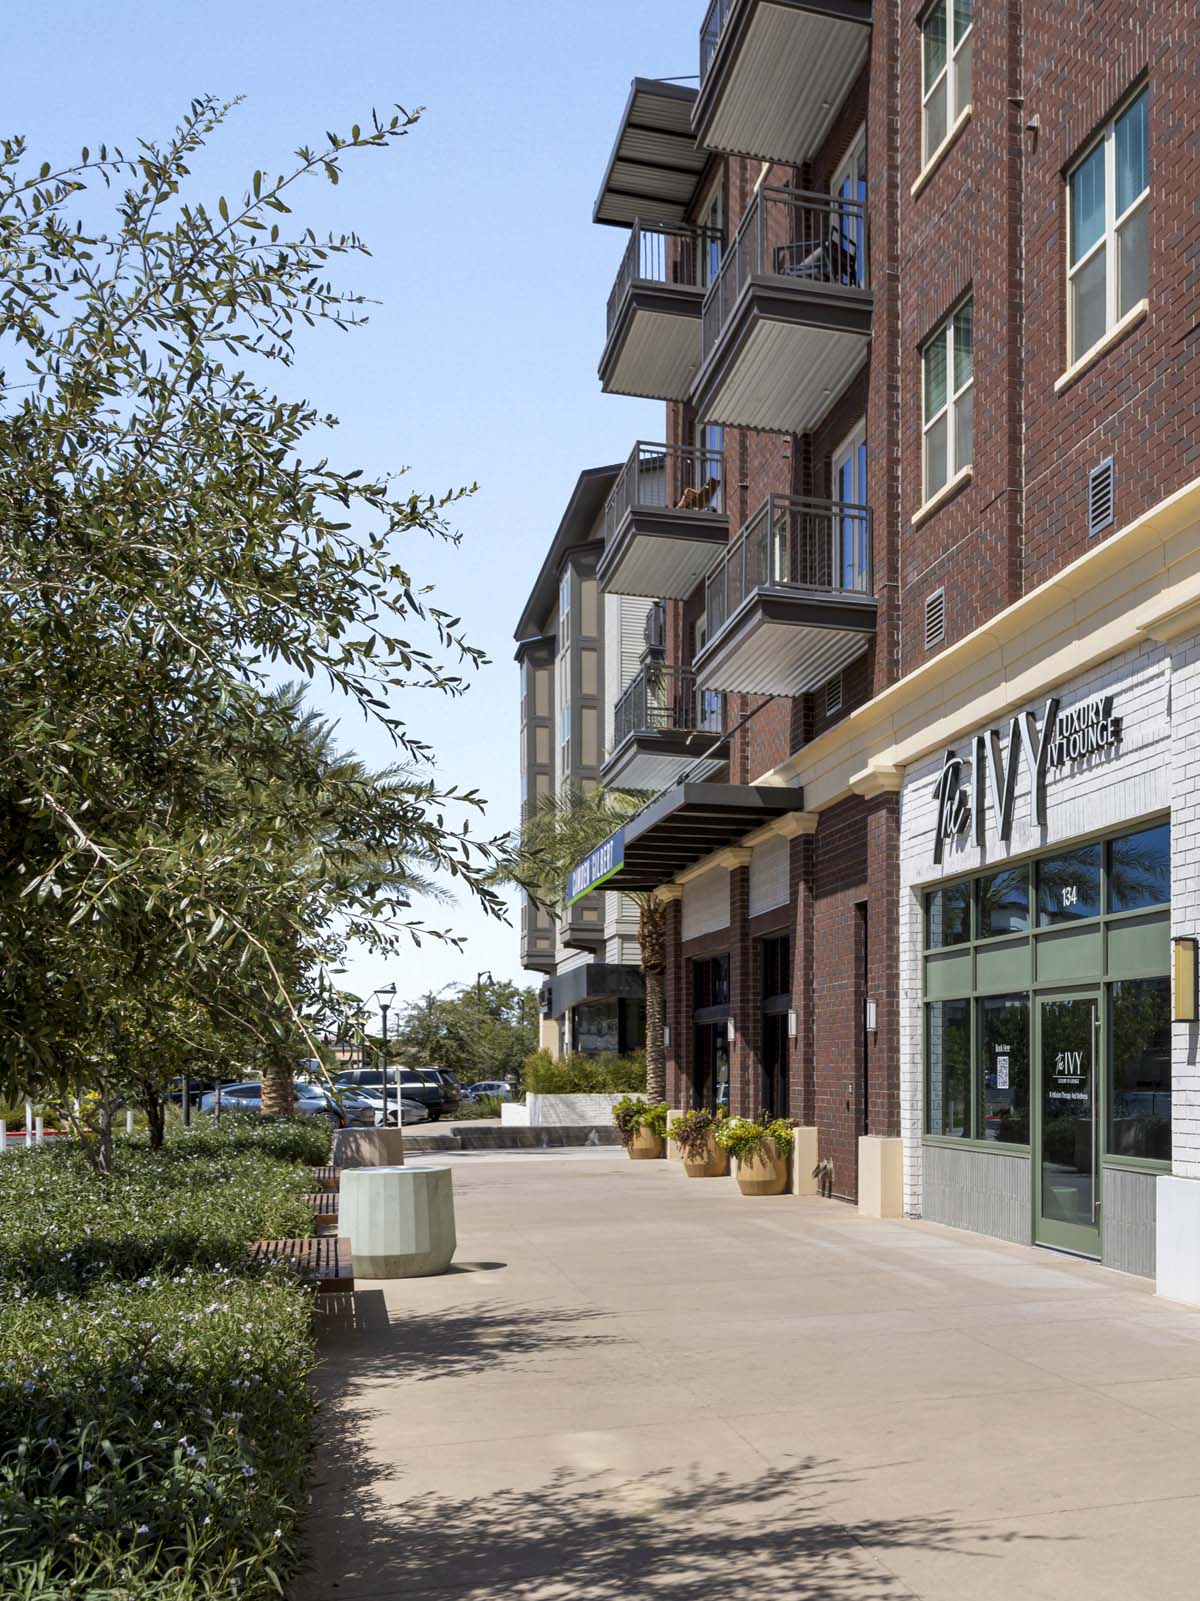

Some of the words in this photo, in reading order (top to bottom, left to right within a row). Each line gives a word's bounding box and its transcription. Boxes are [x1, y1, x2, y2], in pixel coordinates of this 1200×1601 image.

[1056, 697, 1110, 740] LUXURY
[1047, 742, 1060, 768] IV
[1063, 717, 1119, 762] LOUNGE
[932, 750, 970, 864] The
[971, 698, 1058, 849] IVY
[1062, 886, 1077, 907] 134
[1065, 1051, 1083, 1075] IVY
